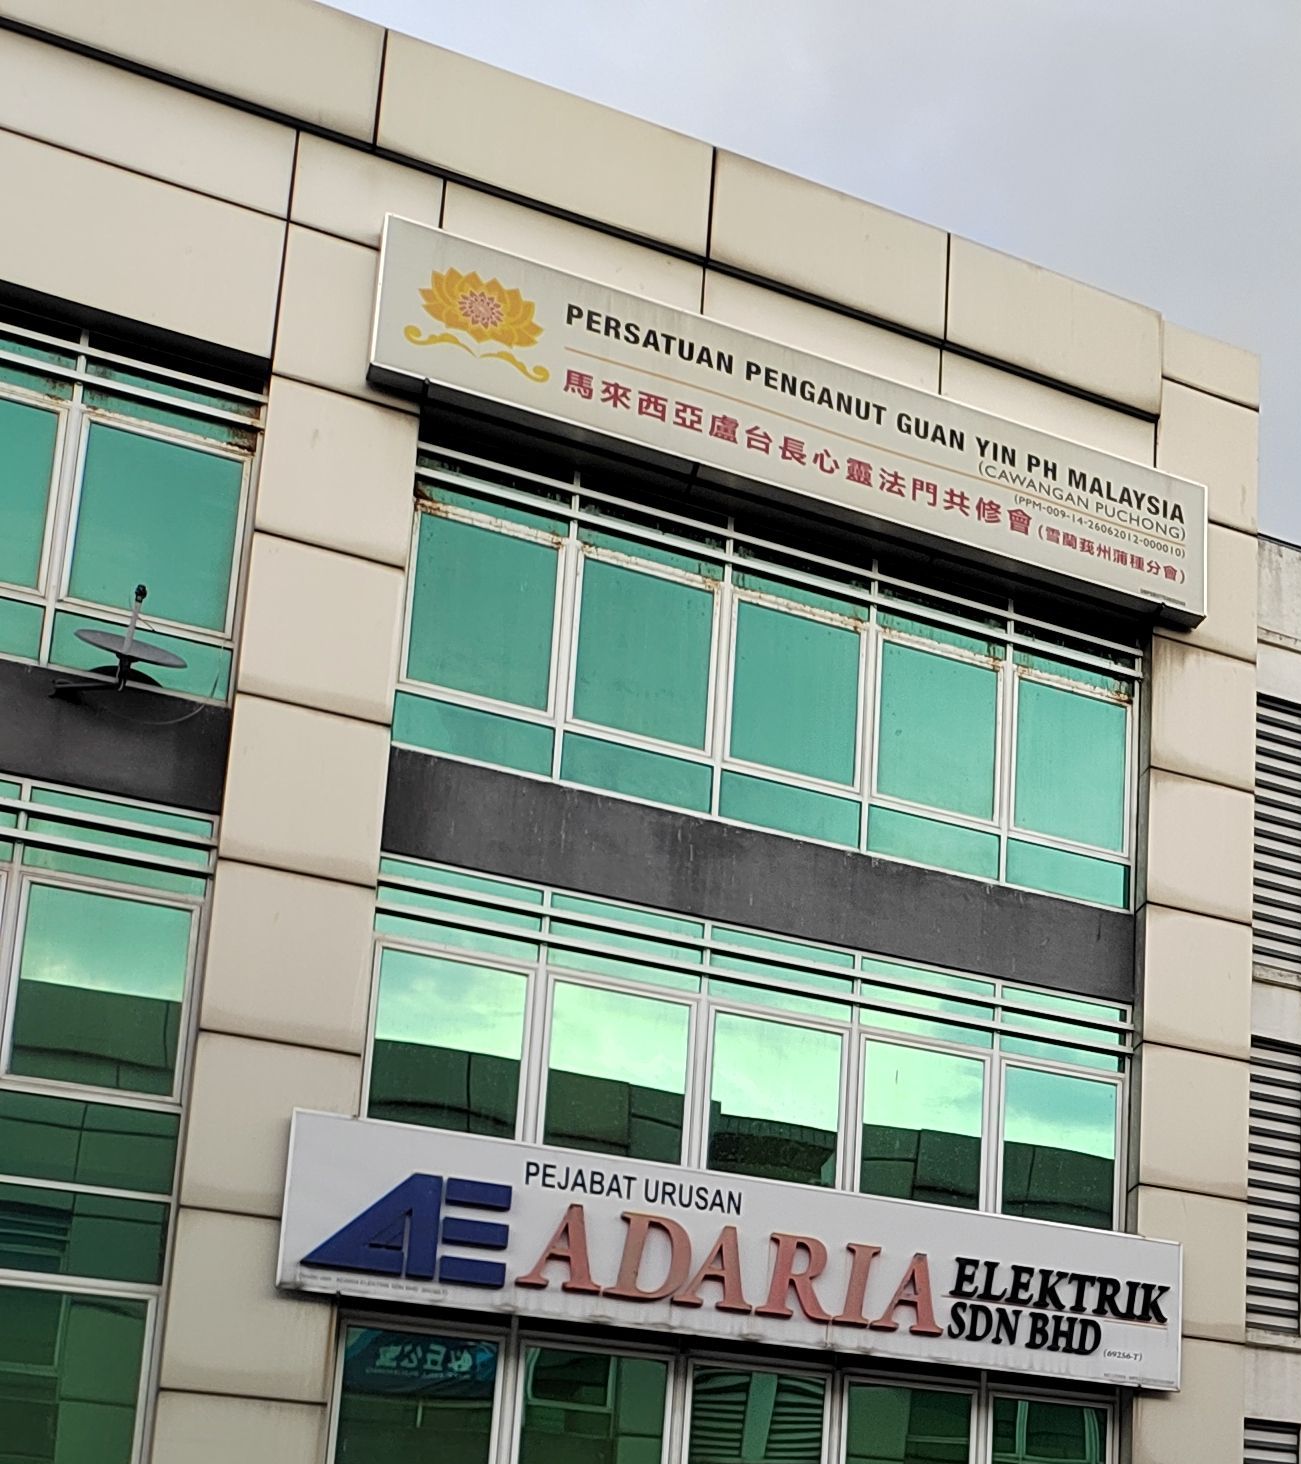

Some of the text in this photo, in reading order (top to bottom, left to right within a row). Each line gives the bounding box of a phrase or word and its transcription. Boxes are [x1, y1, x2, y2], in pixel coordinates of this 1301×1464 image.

[563, 369, 1032, 536] 馬來西亞盧台長心靈法門共修會
[566, 304, 1185, 524] PERSATUAN PENGANUT GUAN YIN PH MALAYSIA
[978, 460, 1186, 541] (CAWANGAN PUCHONG)
[524, 1161, 742, 1216] PEJABAT URUSAN
[515, 1203, 944, 1338] ADARIA
[949, 1256, 1171, 1324] ELEKTRIK
[947, 1301, 1023, 1346] SDN
[1025, 1312, 1102, 1355] BHD
